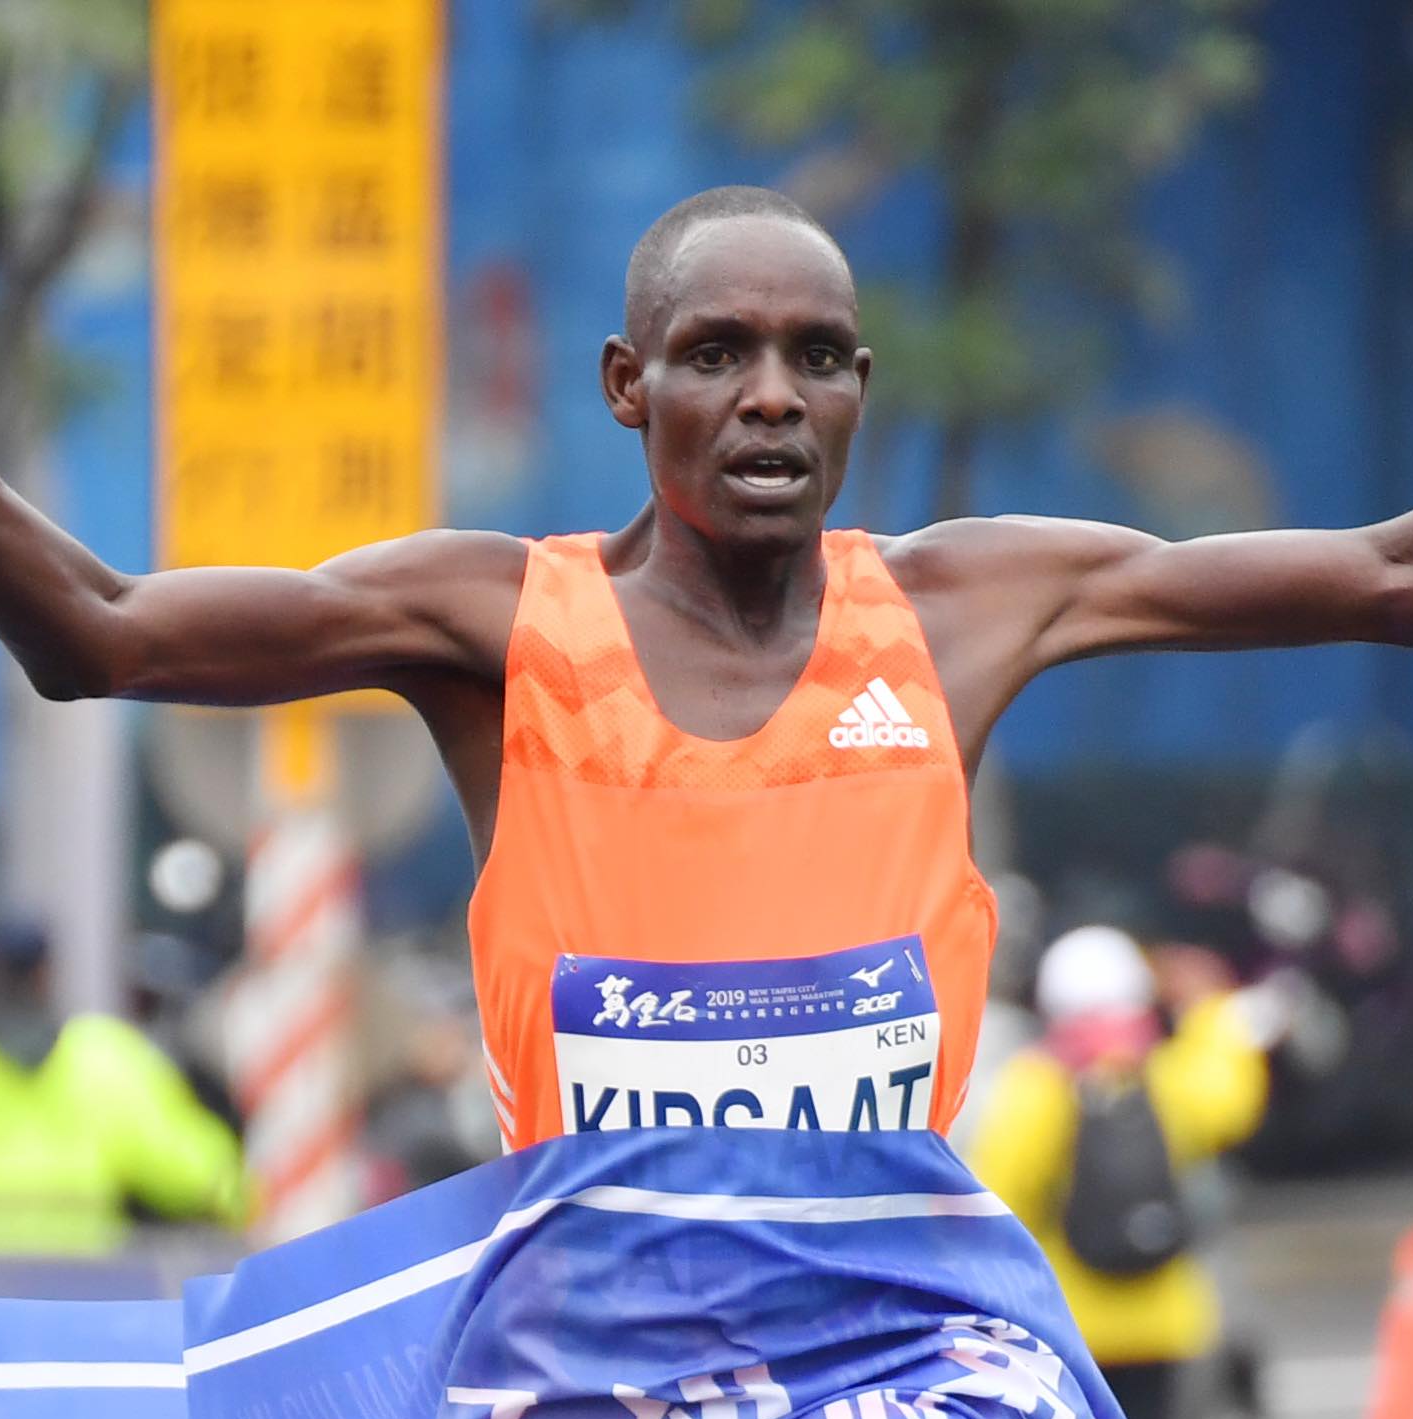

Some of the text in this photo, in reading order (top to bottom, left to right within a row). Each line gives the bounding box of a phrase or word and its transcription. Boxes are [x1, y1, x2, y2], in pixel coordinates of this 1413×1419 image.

[828, 720, 929, 749] adidas
[706, 989, 746, 1007] 2019
[852, 990, 903, 1016] acer
[876, 1021, 926, 1049] KEN
[737, 1044, 768, 1066] 03
